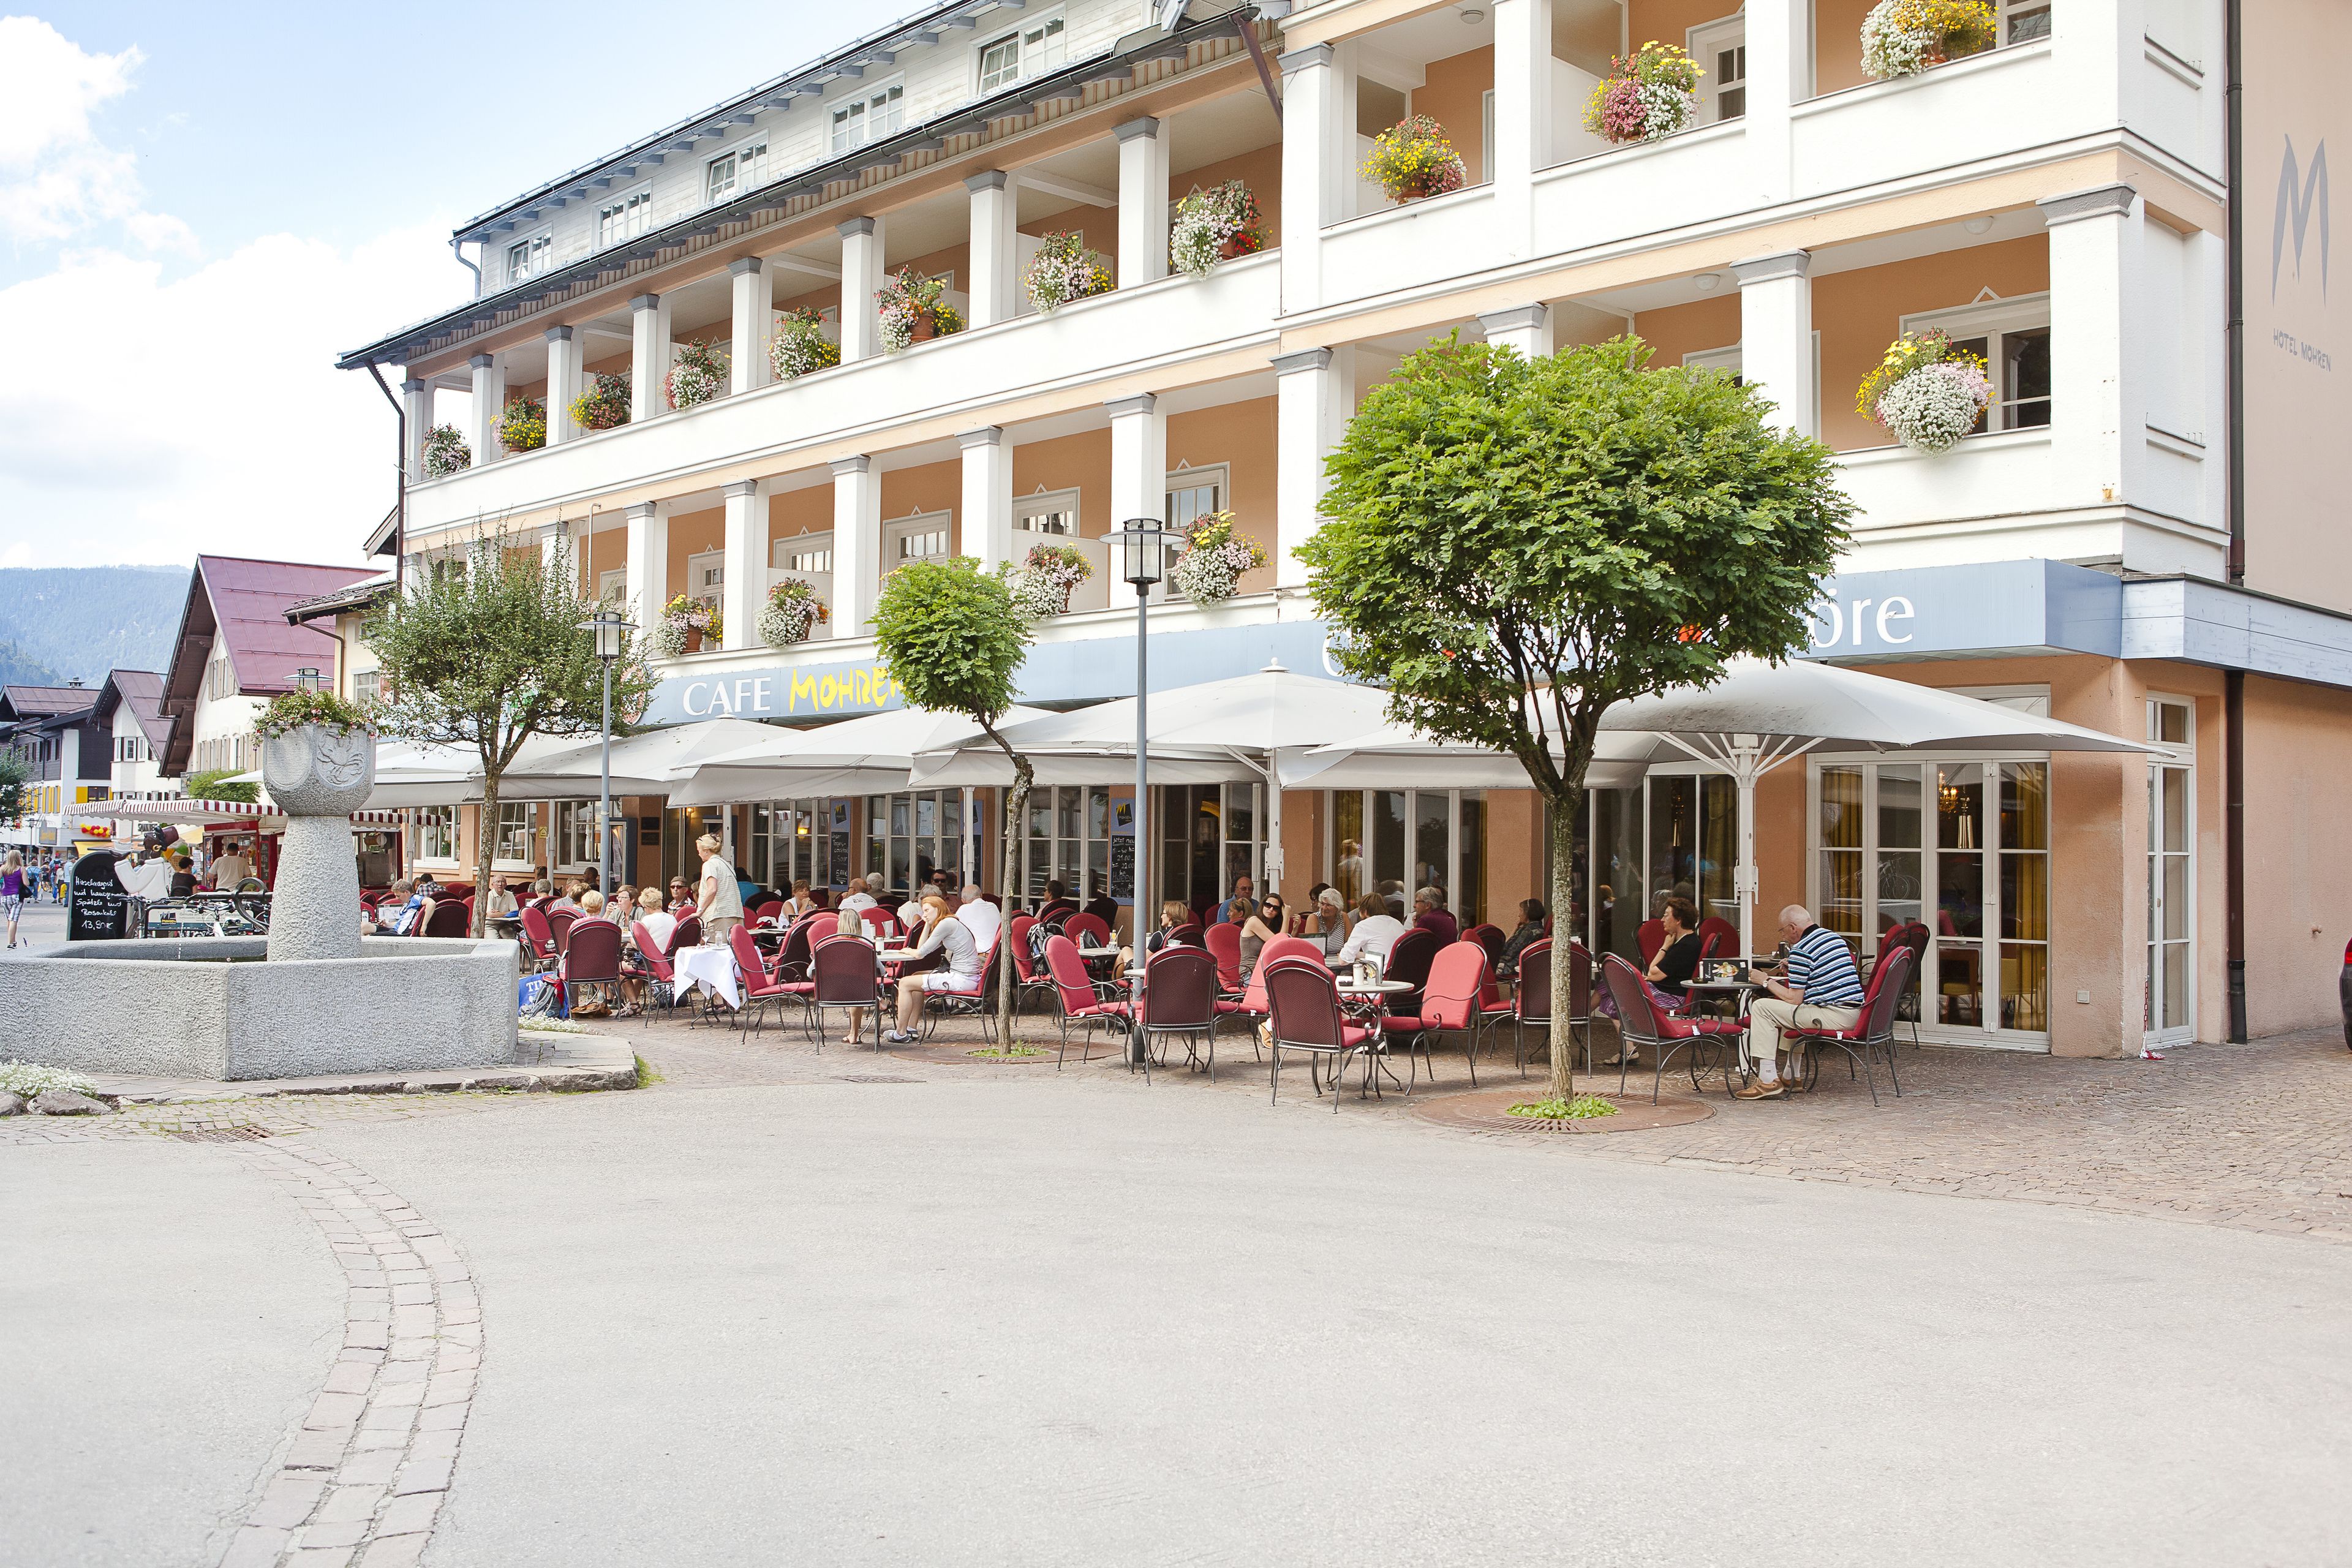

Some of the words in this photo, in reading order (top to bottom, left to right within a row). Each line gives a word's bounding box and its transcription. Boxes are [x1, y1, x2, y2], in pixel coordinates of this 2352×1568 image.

[2273, 328, 2297, 356] HOTEL
[2301, 342, 2331, 372] MOHREN
[1806, 587, 1915, 649] öre
[683, 677, 772, 716] CAFE
